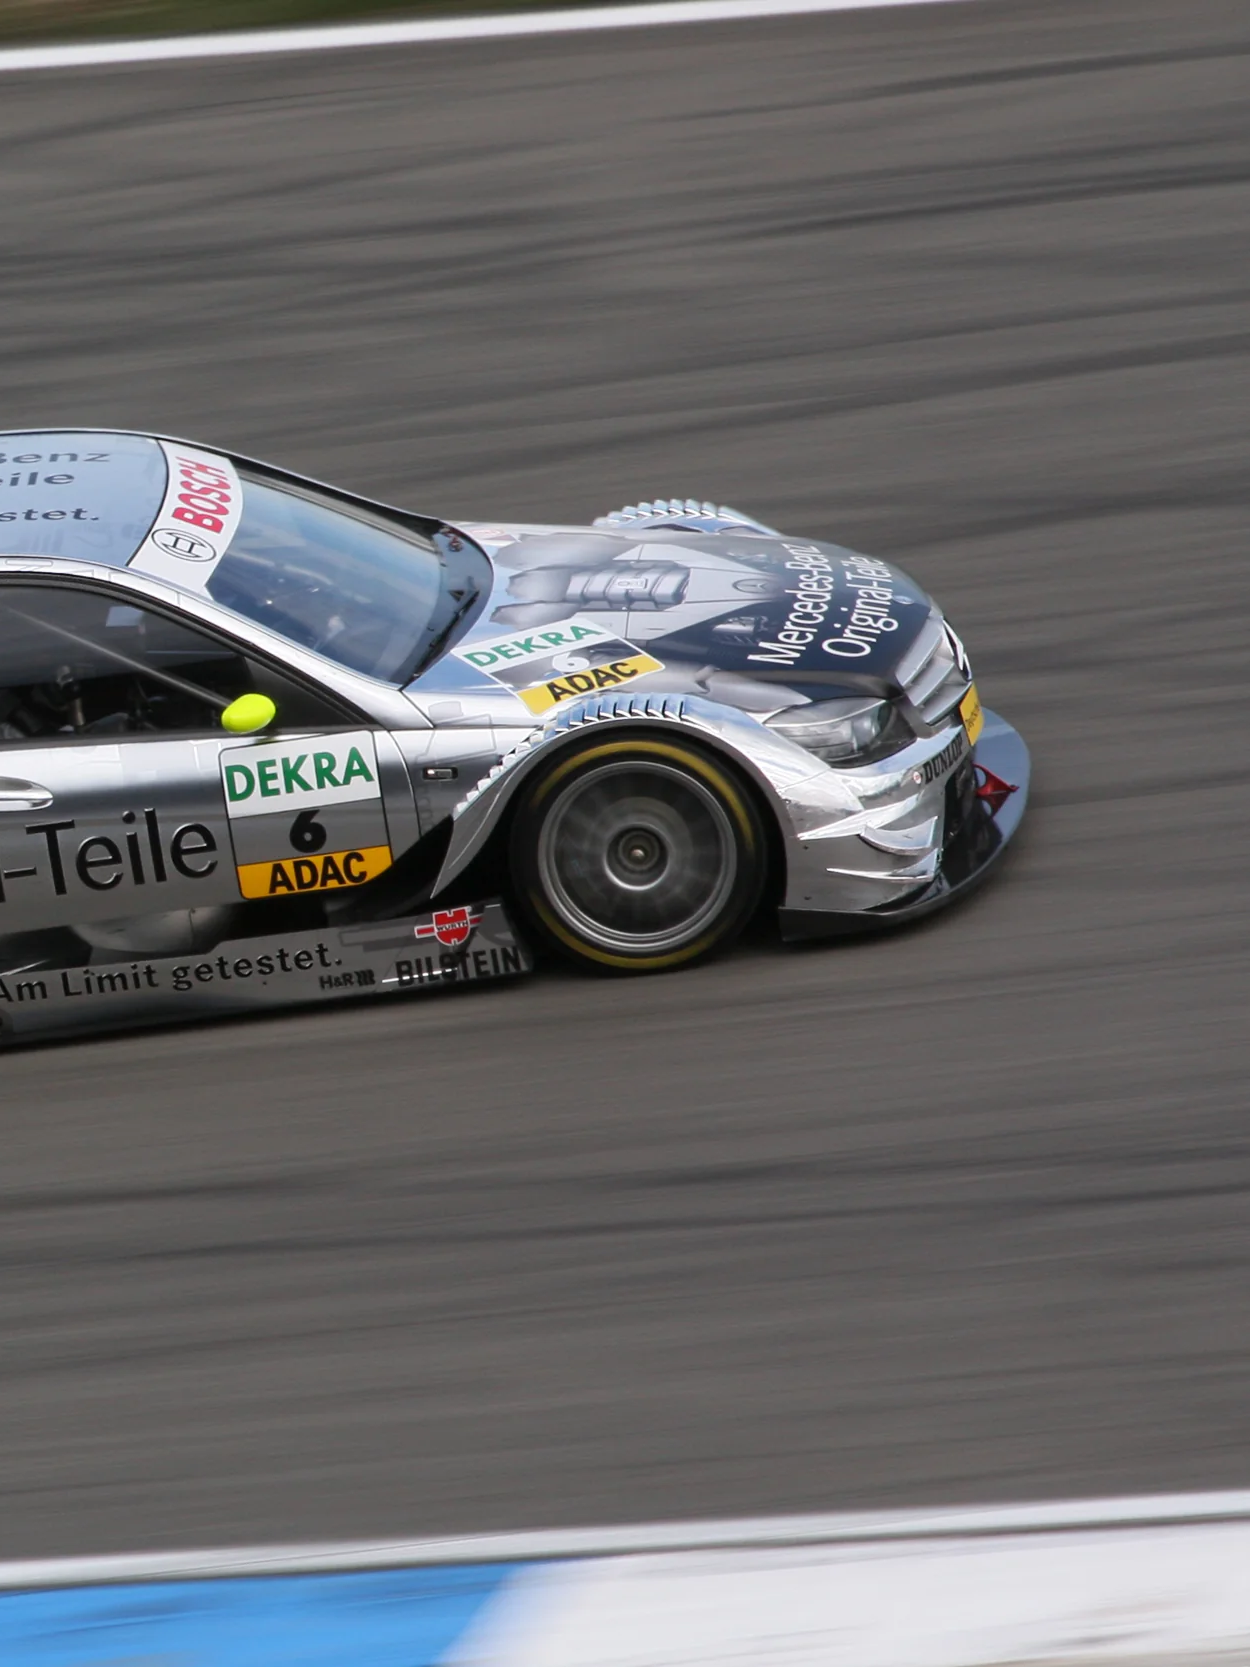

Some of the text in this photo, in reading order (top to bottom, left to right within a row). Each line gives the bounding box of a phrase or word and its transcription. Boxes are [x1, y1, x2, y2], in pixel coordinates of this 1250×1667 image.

[172, 456, 232, 534] BOSCH
[747, 543, 834, 665] Mercedes-Benz
[822, 556, 898, 657] Original-Teile
[463, 625, 605, 667] DEKRA
[552, 652, 590, 672] 6
[546, 662, 639, 702] ADAC
[224, 747, 375, 802] DEKRA
[923, 733, 963, 784] DUNLOP
[290, 809, 327, 853] 6
[269, 851, 367, 894] ADAC
[60, 960, 159, 998] Limit
[172, 942, 343, 991] getestet.
[396, 946, 522, 986] BILSTEIN
